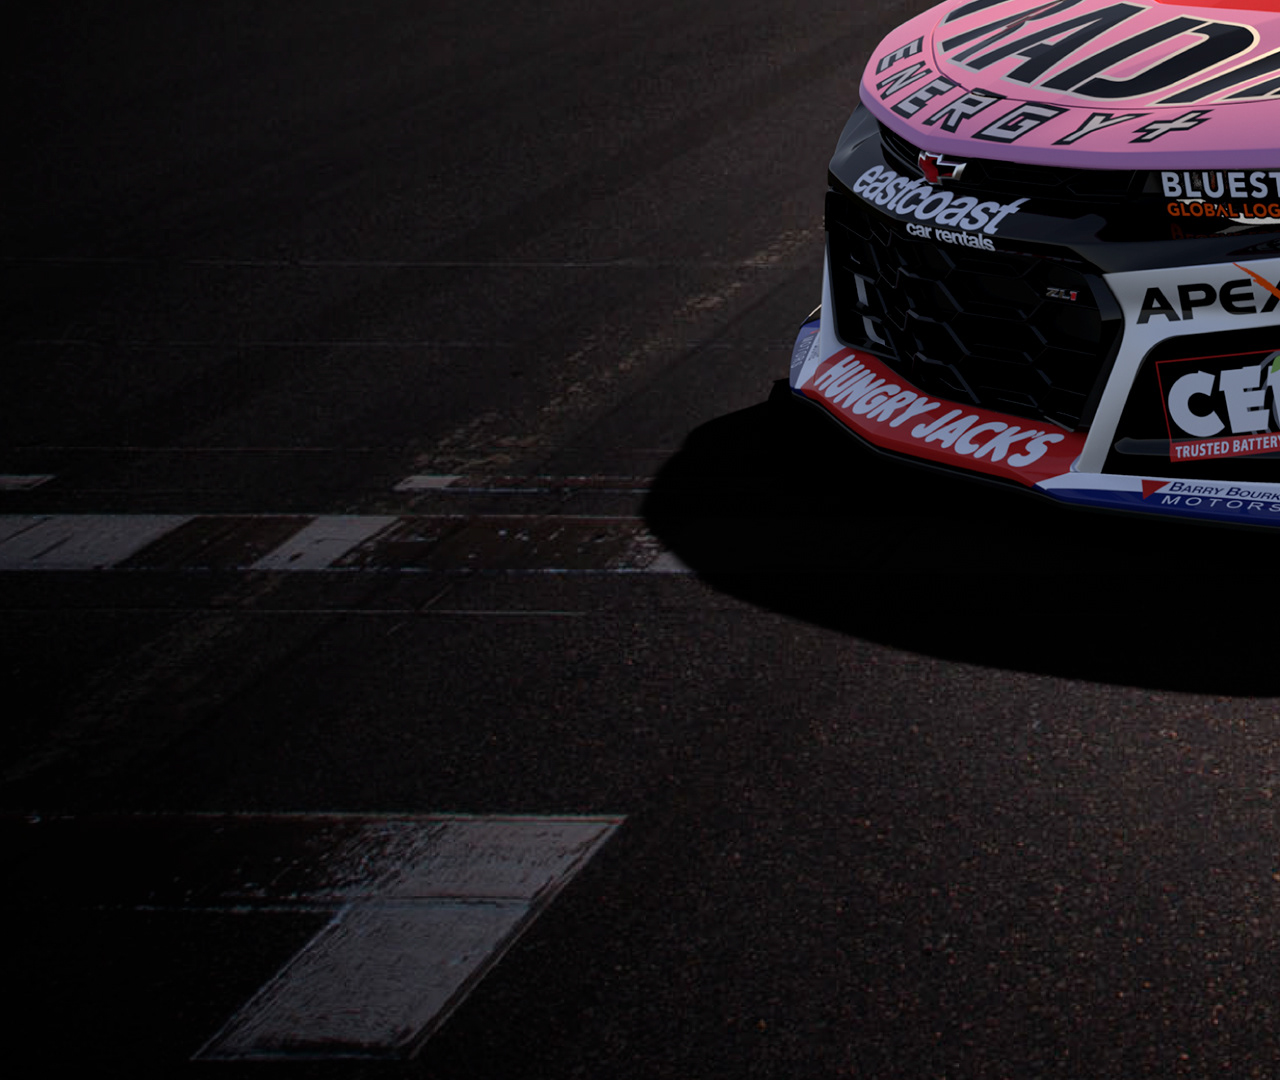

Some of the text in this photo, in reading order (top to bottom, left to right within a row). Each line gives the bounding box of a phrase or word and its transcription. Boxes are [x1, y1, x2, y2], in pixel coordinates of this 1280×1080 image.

[853, 165, 1031, 235] eastcoast
[1166, 201, 1239, 218] GLOBAL
[906, 222, 996, 251] car rentals
[813, 354, 1065, 468] HUNGRY JACK'S
[1175, 441, 1230, 459] TRUSTED
[1168, 481, 1225, 497] BARRY
